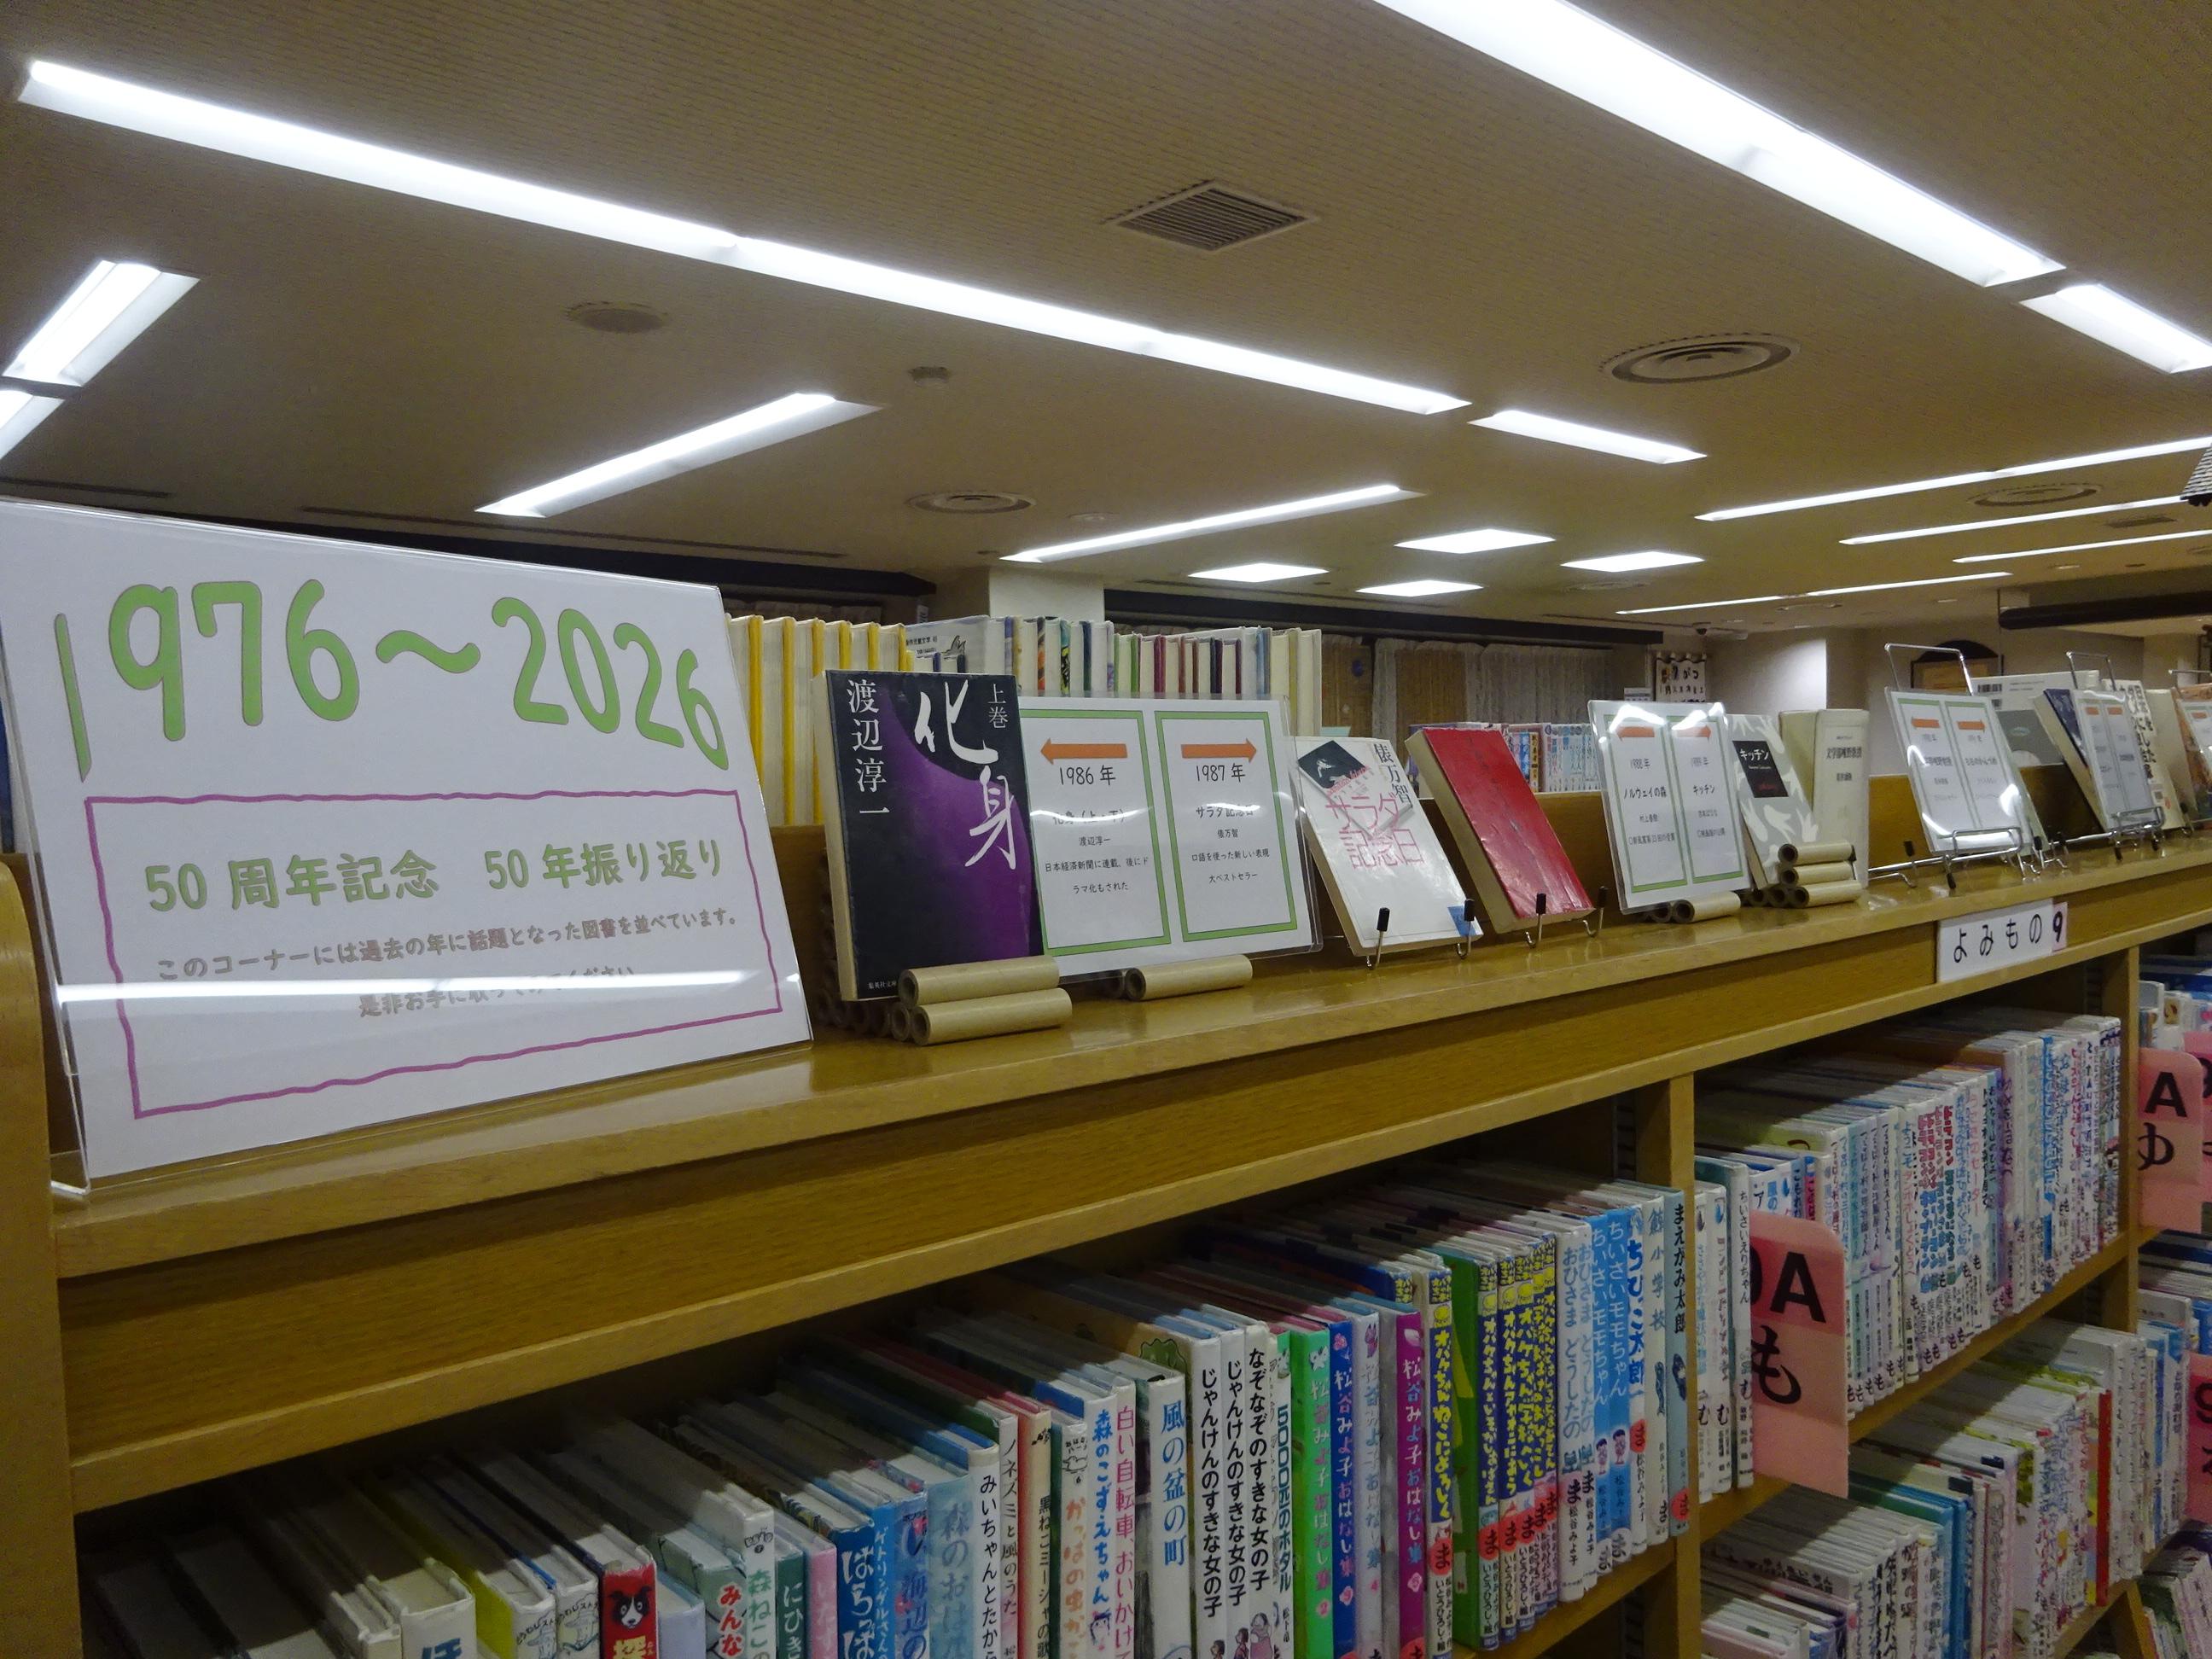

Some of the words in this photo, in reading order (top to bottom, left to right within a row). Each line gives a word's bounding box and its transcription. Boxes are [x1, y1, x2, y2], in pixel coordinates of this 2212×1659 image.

[847, 679, 889, 815] 渡辺淳一
[987, 684, 1010, 730] 上巻
[1740, 748, 1770, 761] キッチン
[914, 679, 1016, 870] 化身
[1374, 743, 1413, 810] 俵万智
[1624, 785, 1668, 800] ノルウェイの森
[1693, 783, 1715, 795] キッチン
[1073, 881, 1129, 894] ラマ化もされた
[1079, 835, 1111, 847] 渡辺淳一
[1209, 871, 1258, 883] 大ベストセラー
[1674, 1204, 1686, 1334] まえがみ太郎
[1739, 1190, 1749, 1304] ちいさいえりちゃん
[1592, 1228, 1608, 1406] ちいさいモモちゃん
[1609, 1221, 1626, 1397] ちいさいモモちゃん
[1000, 1438, 1018, 1615] ノネズミと風のうた
[1091, 1408, 1113, 1605] 森のこずえちゃん
[1161, 1400, 1187, 1568] 風の盆の町
[1201, 1369, 1223, 1618] じゃんけんのすきな女の子
[1226, 1360, 1247, 1607] じゃんけんのすきな女の子
[1249, 1348, 1271, 1592] なぞなぞのすきな女の子
[719, 1585, 742, 1657] みんな
[748, 1569, 772, 1659] 森ねこ
